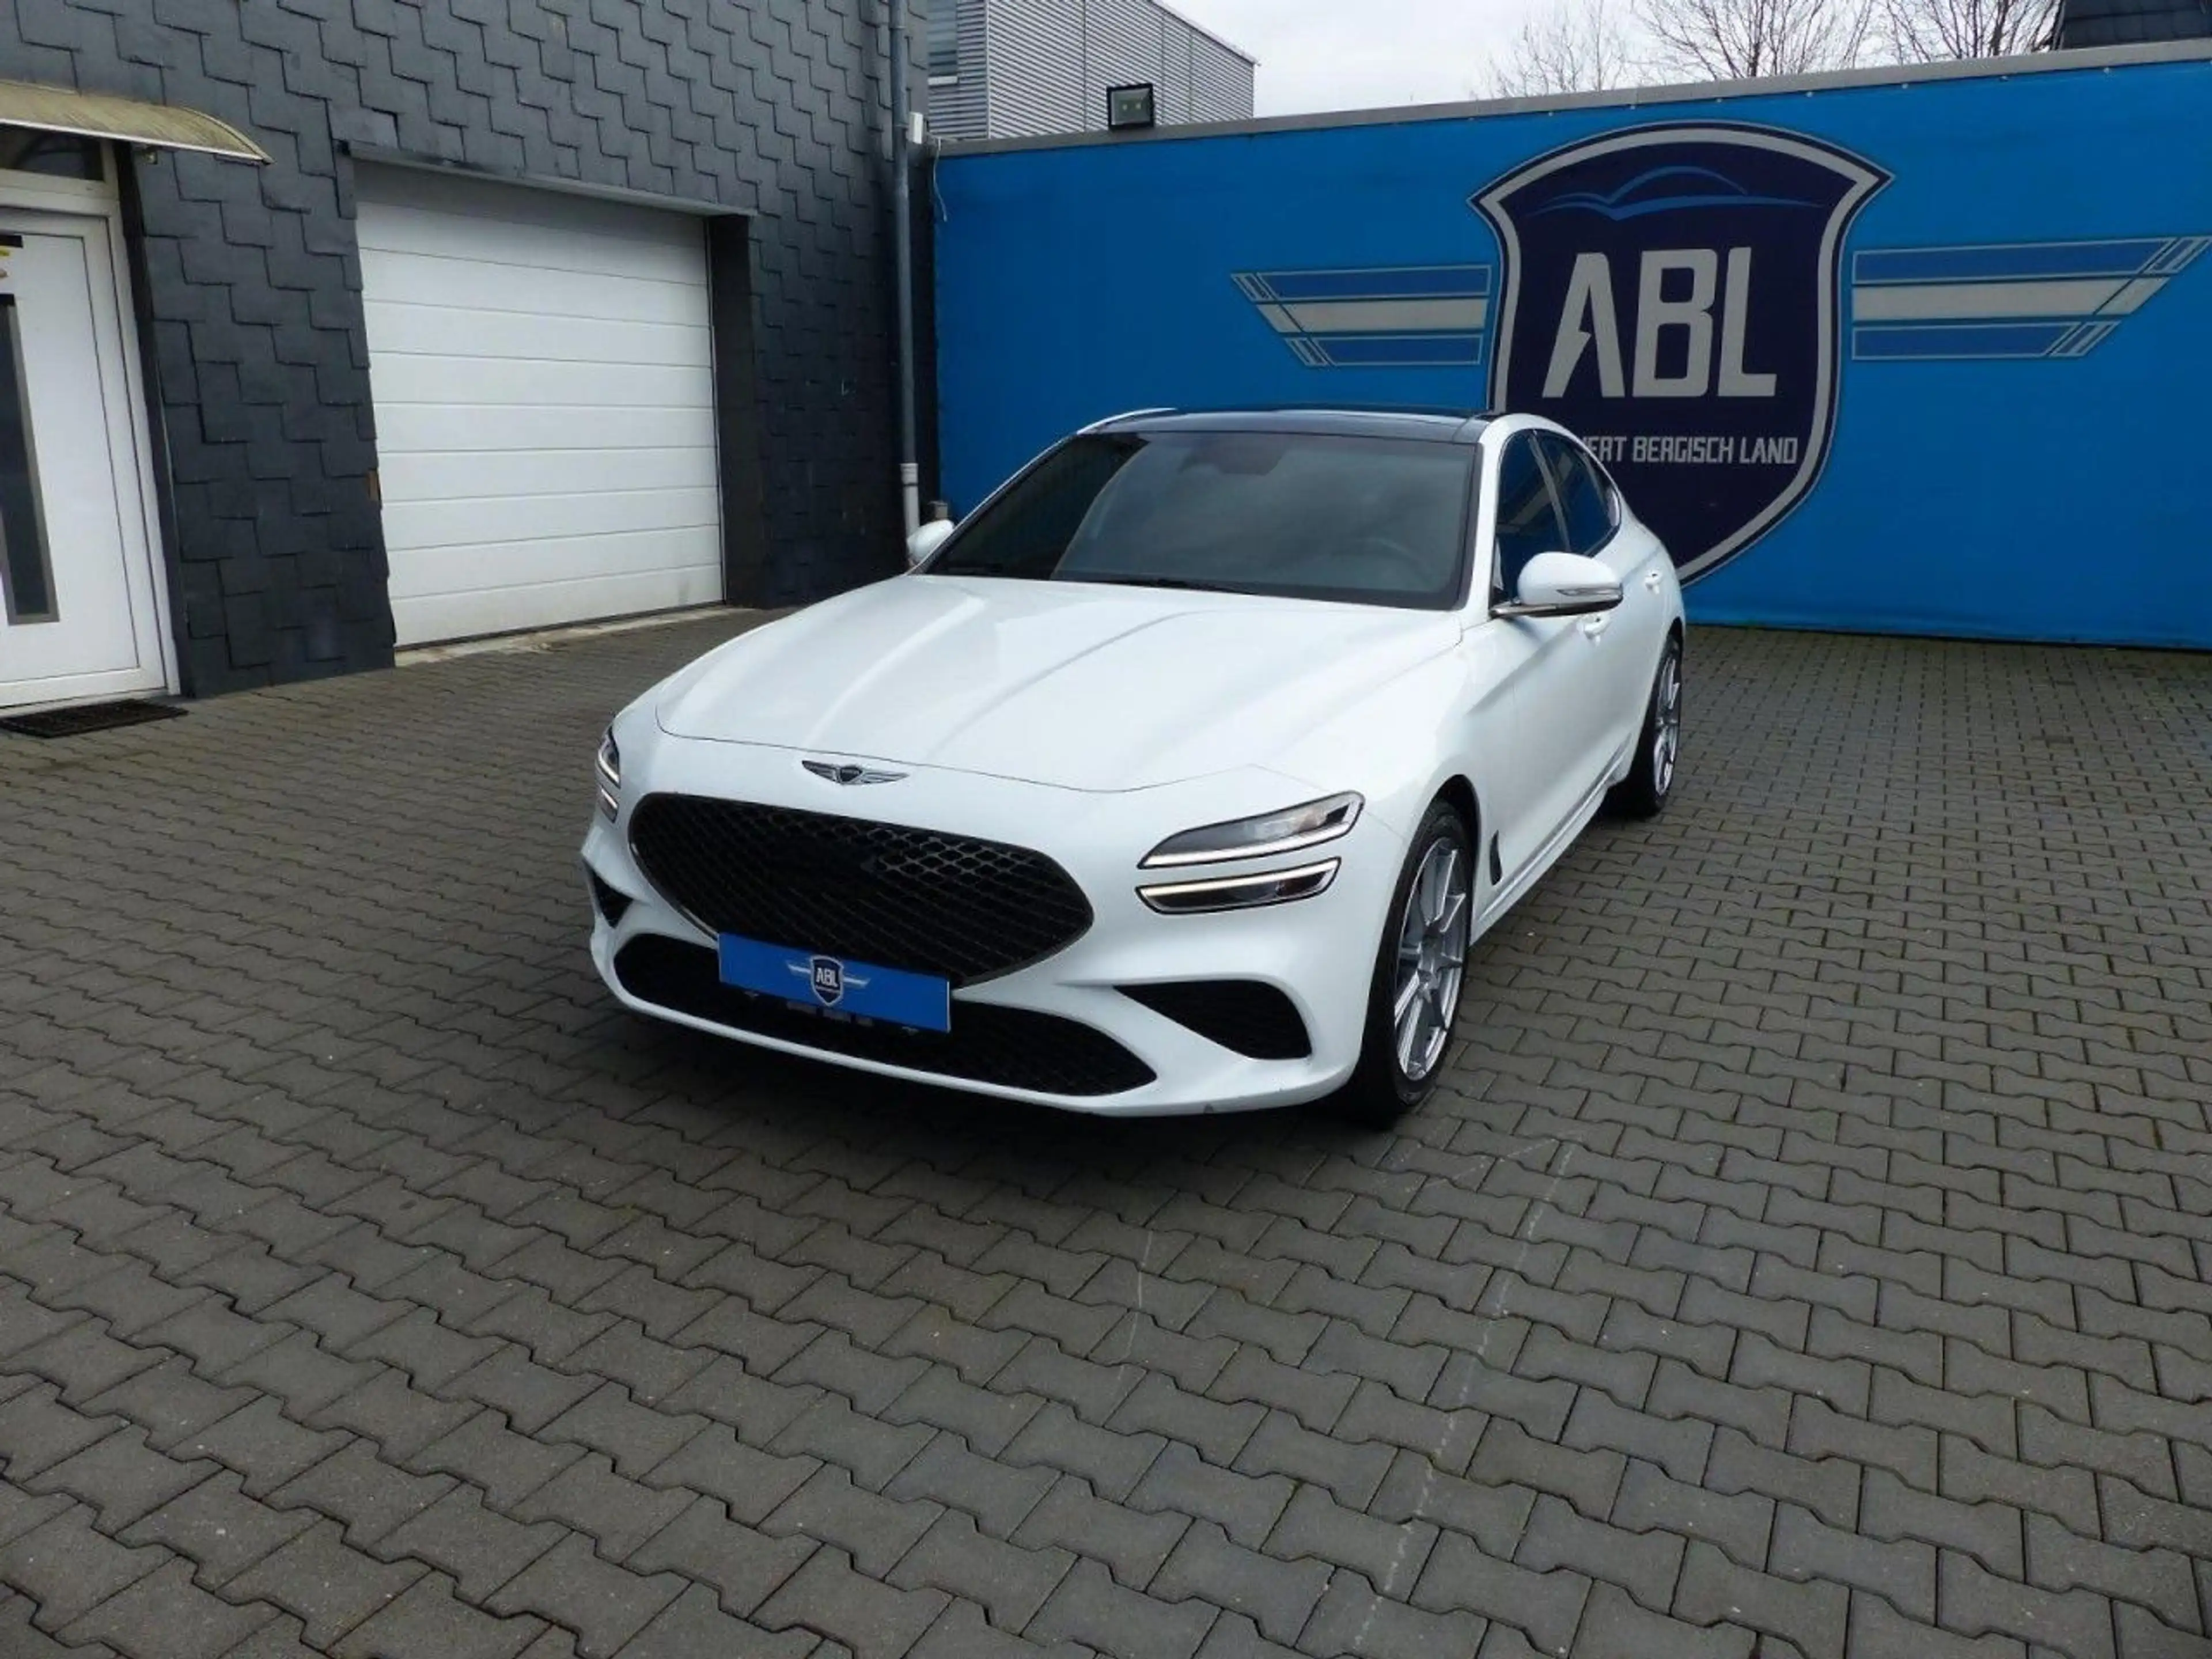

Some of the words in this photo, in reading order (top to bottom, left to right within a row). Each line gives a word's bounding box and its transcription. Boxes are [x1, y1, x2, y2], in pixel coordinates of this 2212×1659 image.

[1542, 247, 1777, 397] ABL
[1584, 435, 1627, 462] ERT
[1633, 436, 1734, 463] BERGISCH
[1738, 437, 1798, 464] LAND
[816, 967, 838, 987] ABL
